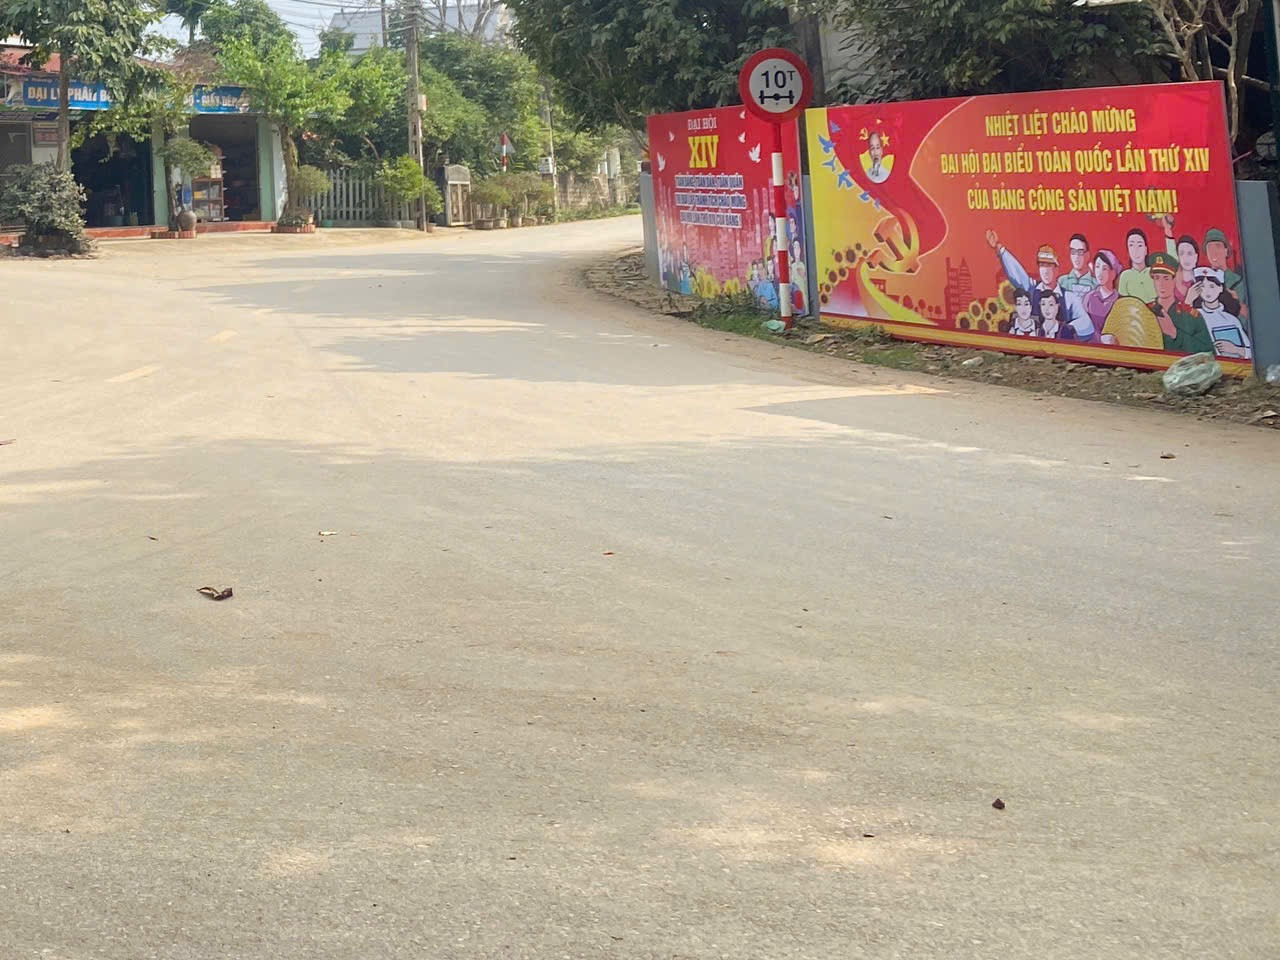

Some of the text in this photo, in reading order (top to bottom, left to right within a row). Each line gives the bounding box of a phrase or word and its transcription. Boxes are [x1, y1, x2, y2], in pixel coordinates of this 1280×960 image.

[28, 87, 47, 101] ĐẠI
[688, 113, 717, 133] ĐẠI HỘI
[985, 104, 1136, 140] NHIỆT LIỆT CHÀO MỪNG
[688, 135, 719, 169] XIV
[940, 140, 1209, 178] ĐẠI HỘI ĐẠI BIỂU TOÀN QUỐC LẦN THỨ XIV
[967, 181, 1178, 217] CỦA ĐẢNG CỘNG SẢN VIỆT NAM!
